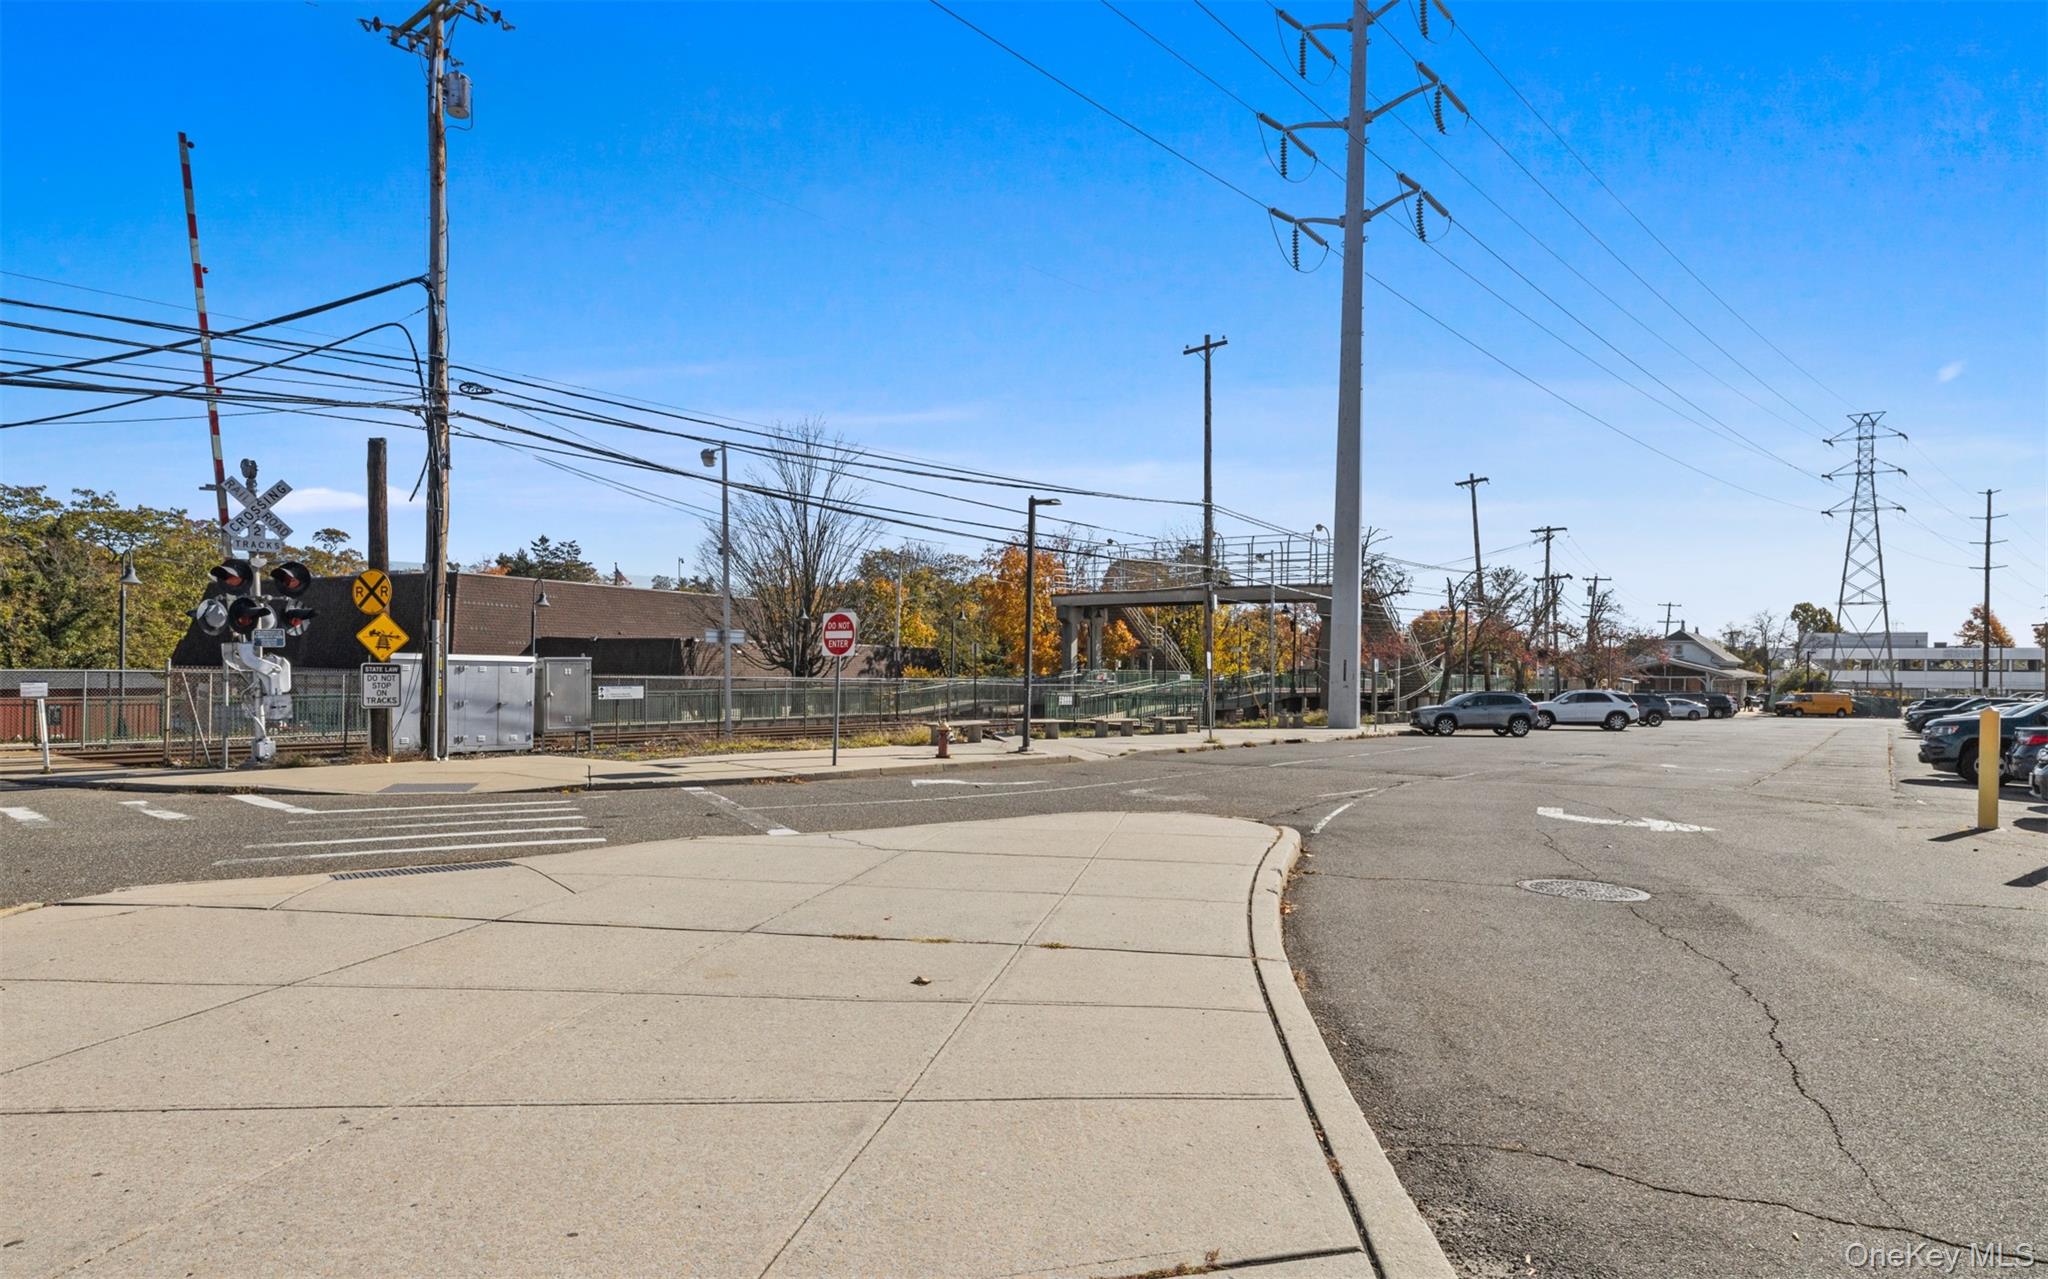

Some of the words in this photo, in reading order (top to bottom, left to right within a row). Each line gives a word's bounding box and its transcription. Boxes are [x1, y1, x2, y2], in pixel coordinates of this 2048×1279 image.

[224, 479, 251, 503] RAIL
[261, 512, 290, 537] ROAD
[229, 485, 287, 532] CROSSING
[253, 525, 261, 537] 2
[235, 540, 281, 550] TRACKS
[355, 587, 364, 598] R
[380, 586, 388, 597] R
[838, 621, 850, 629] NOT
[828, 640, 849, 648] ENTER
[371, 682, 392, 690] STOP
